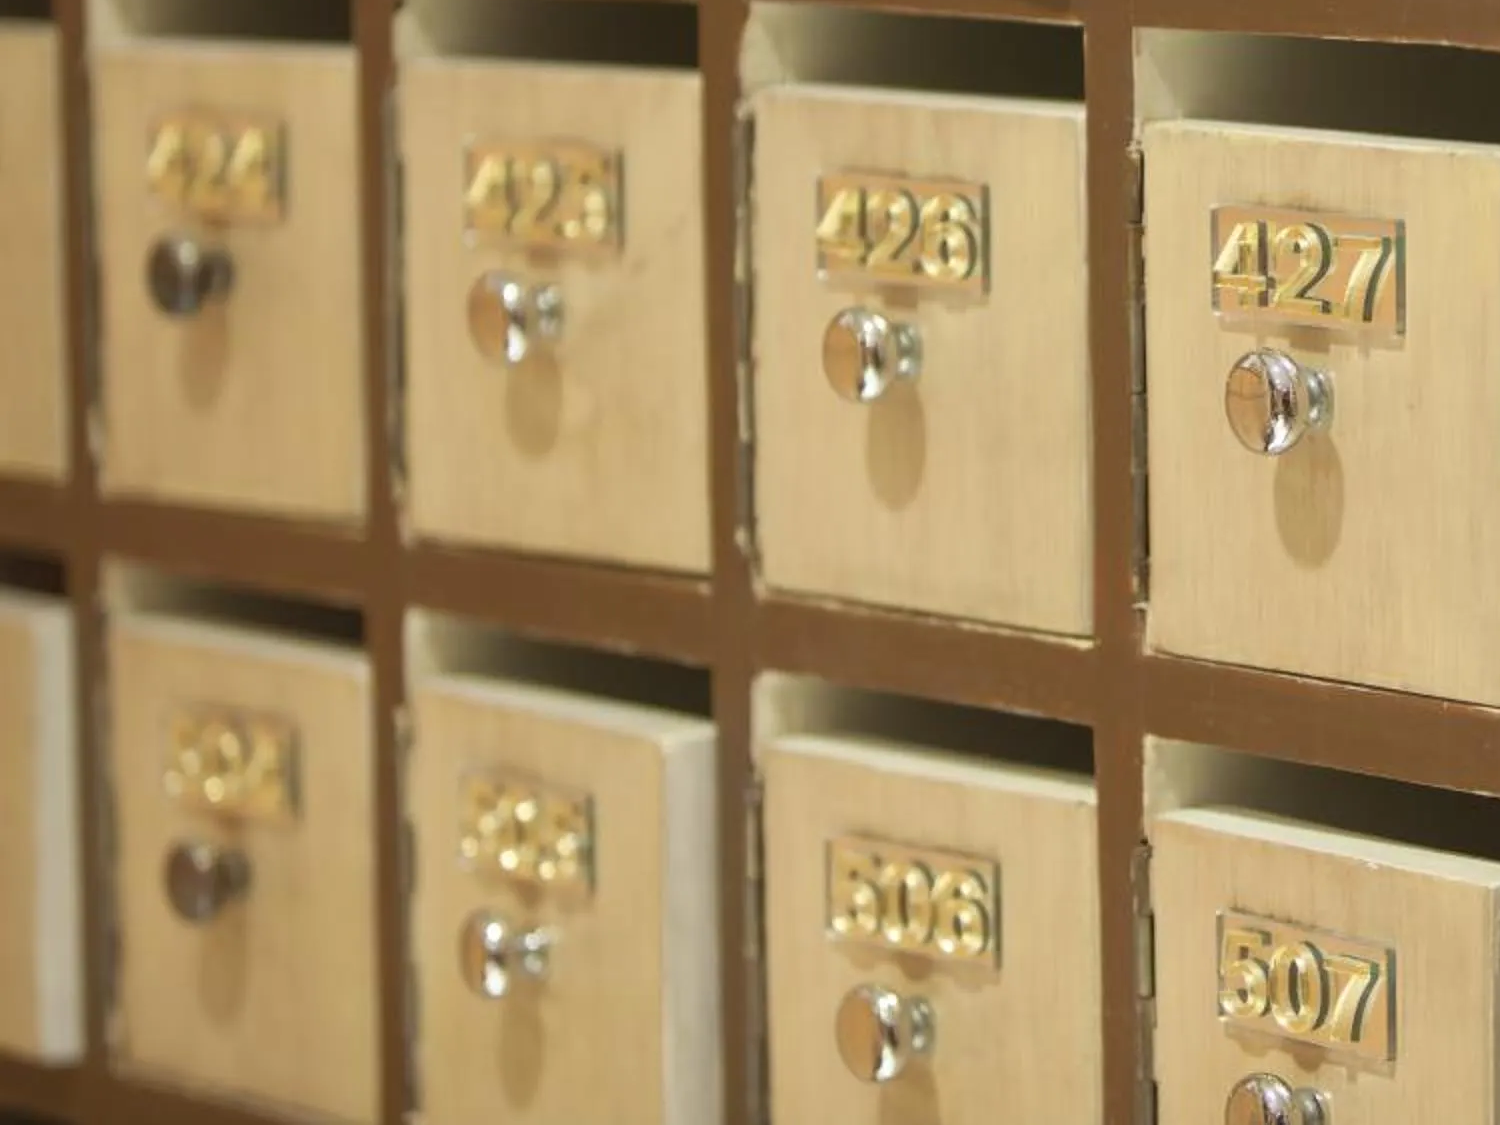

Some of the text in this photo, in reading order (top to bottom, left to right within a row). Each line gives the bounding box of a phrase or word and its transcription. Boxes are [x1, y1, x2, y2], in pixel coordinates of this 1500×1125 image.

[467, 153, 611, 242] 425
[816, 188, 978, 281] 426
[1212, 219, 1393, 323] 427
[830, 851, 990, 957] 506
[1218, 928, 1380, 1045] 507
